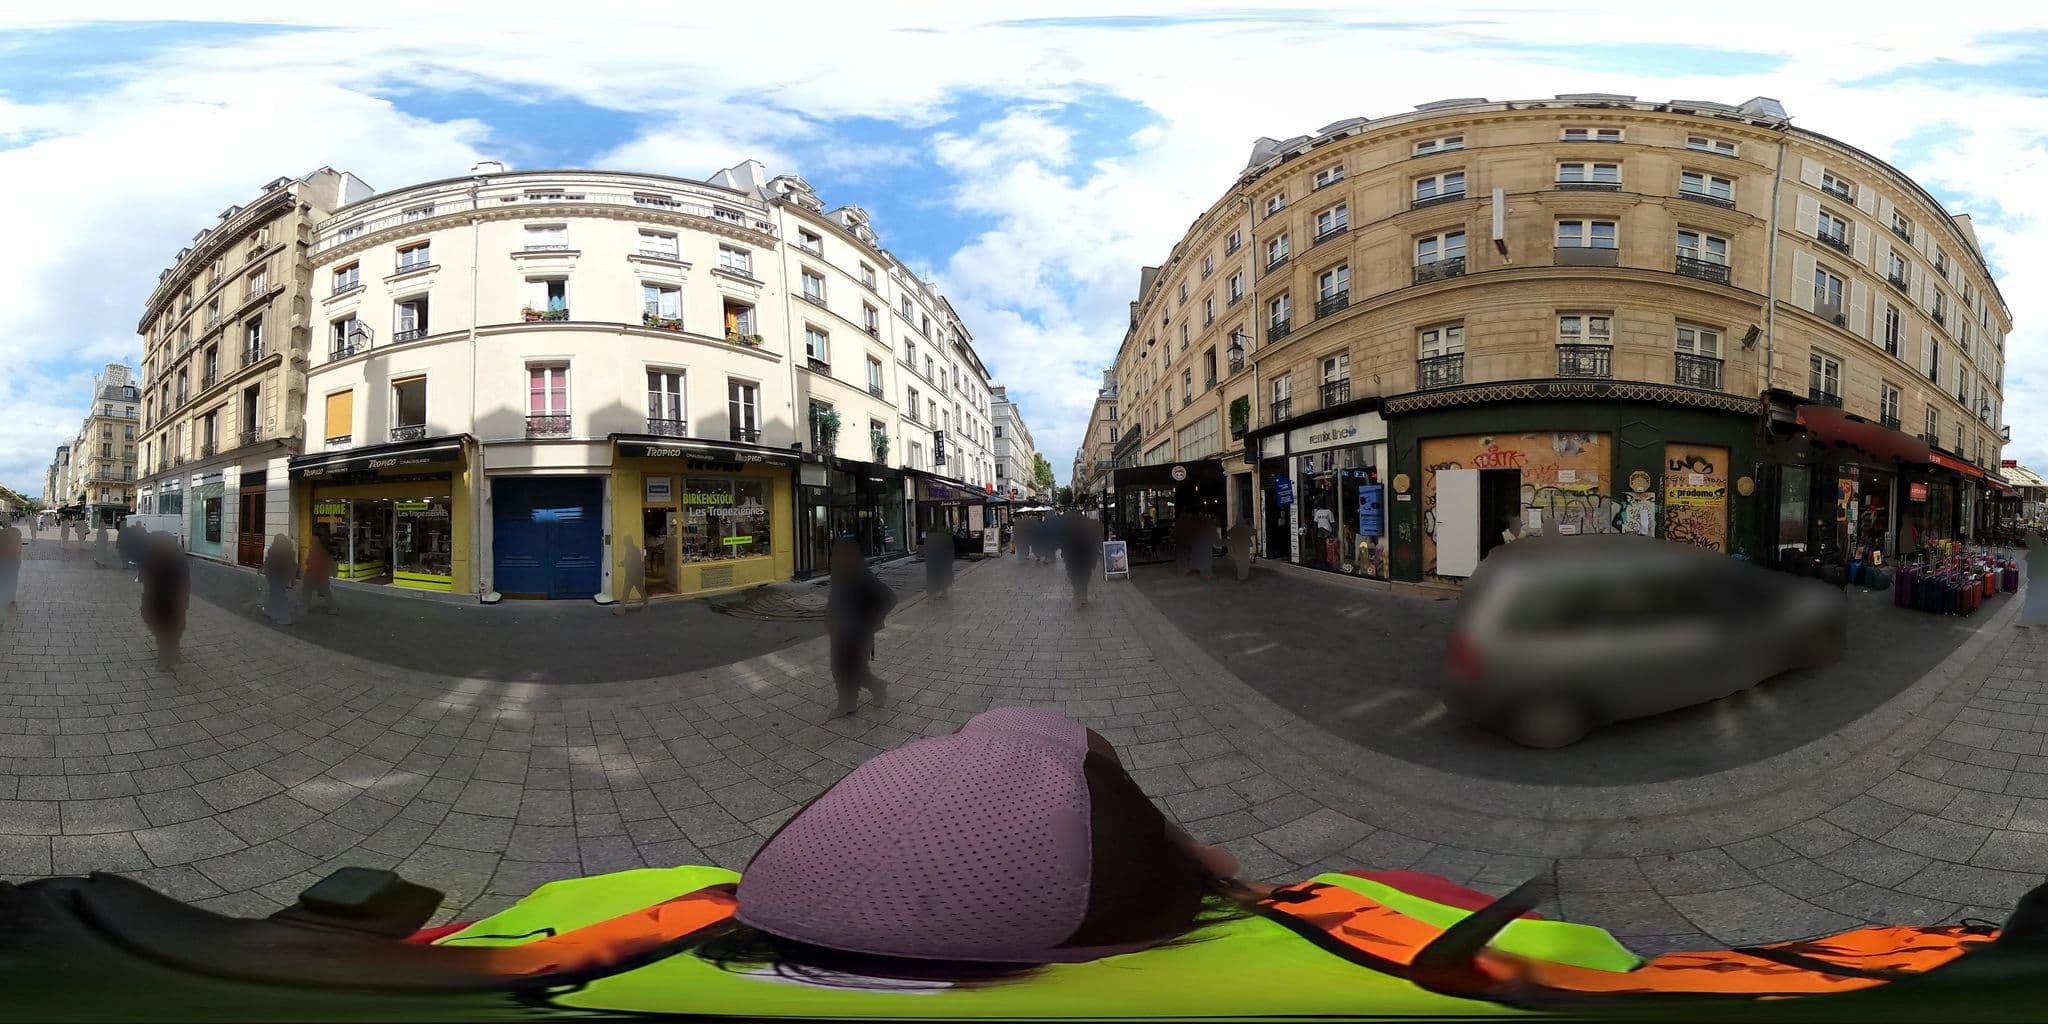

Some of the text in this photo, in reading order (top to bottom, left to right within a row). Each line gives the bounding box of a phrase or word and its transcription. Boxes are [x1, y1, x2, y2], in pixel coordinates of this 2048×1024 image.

[1309, 428, 1348, 444] remix line
[646, 447, 681, 457] TROPICO
[368, 458, 396, 469] TROPICO
[683, 492, 734, 505] BIRKENSTOCK
[1677, 489, 1714, 498] prodomo
[313, 503, 346, 515] HOMME
[690, 507, 706, 516] Les
